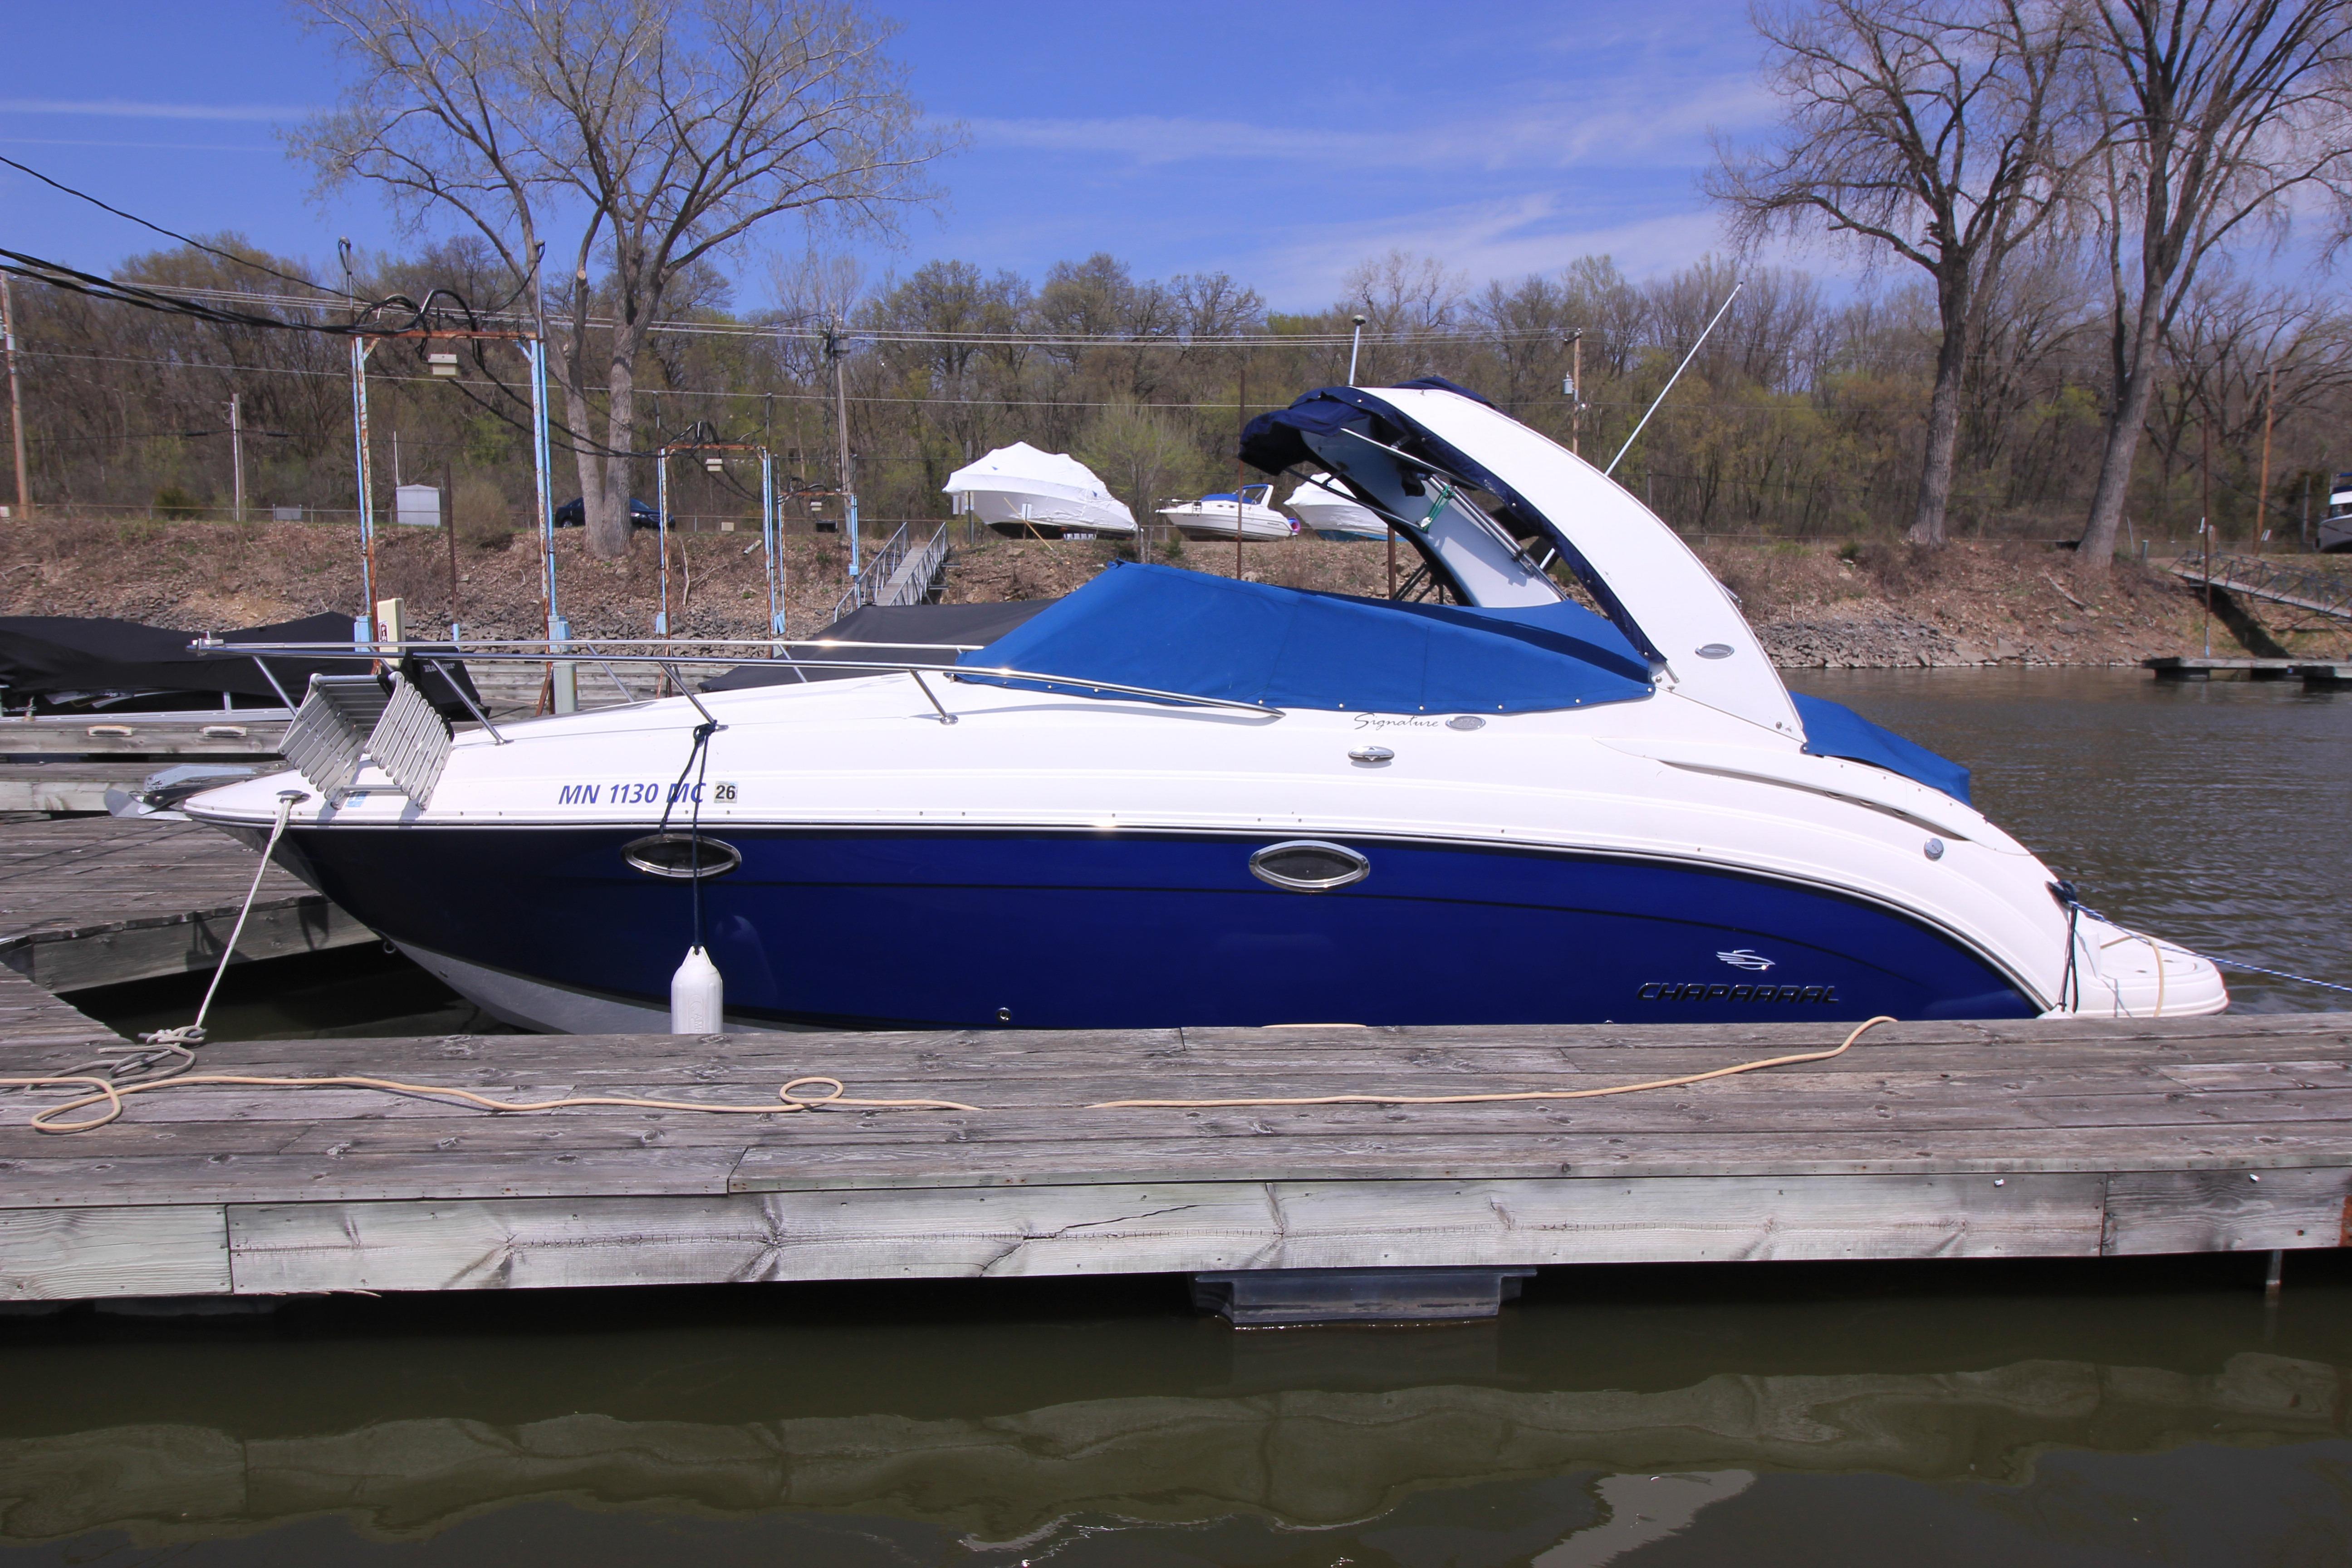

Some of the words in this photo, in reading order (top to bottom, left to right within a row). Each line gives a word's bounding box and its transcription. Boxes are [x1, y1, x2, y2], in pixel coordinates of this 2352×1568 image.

[423, 663, 455, 672] Rager
[1354, 712, 1439, 730] Signature
[559, 784, 601, 804] MN
[610, 784, 659, 804] 1130
[666, 783, 706, 803] MC
[715, 785, 736, 799] 26
[1637, 983, 1839, 1003] CHAPARRAL
